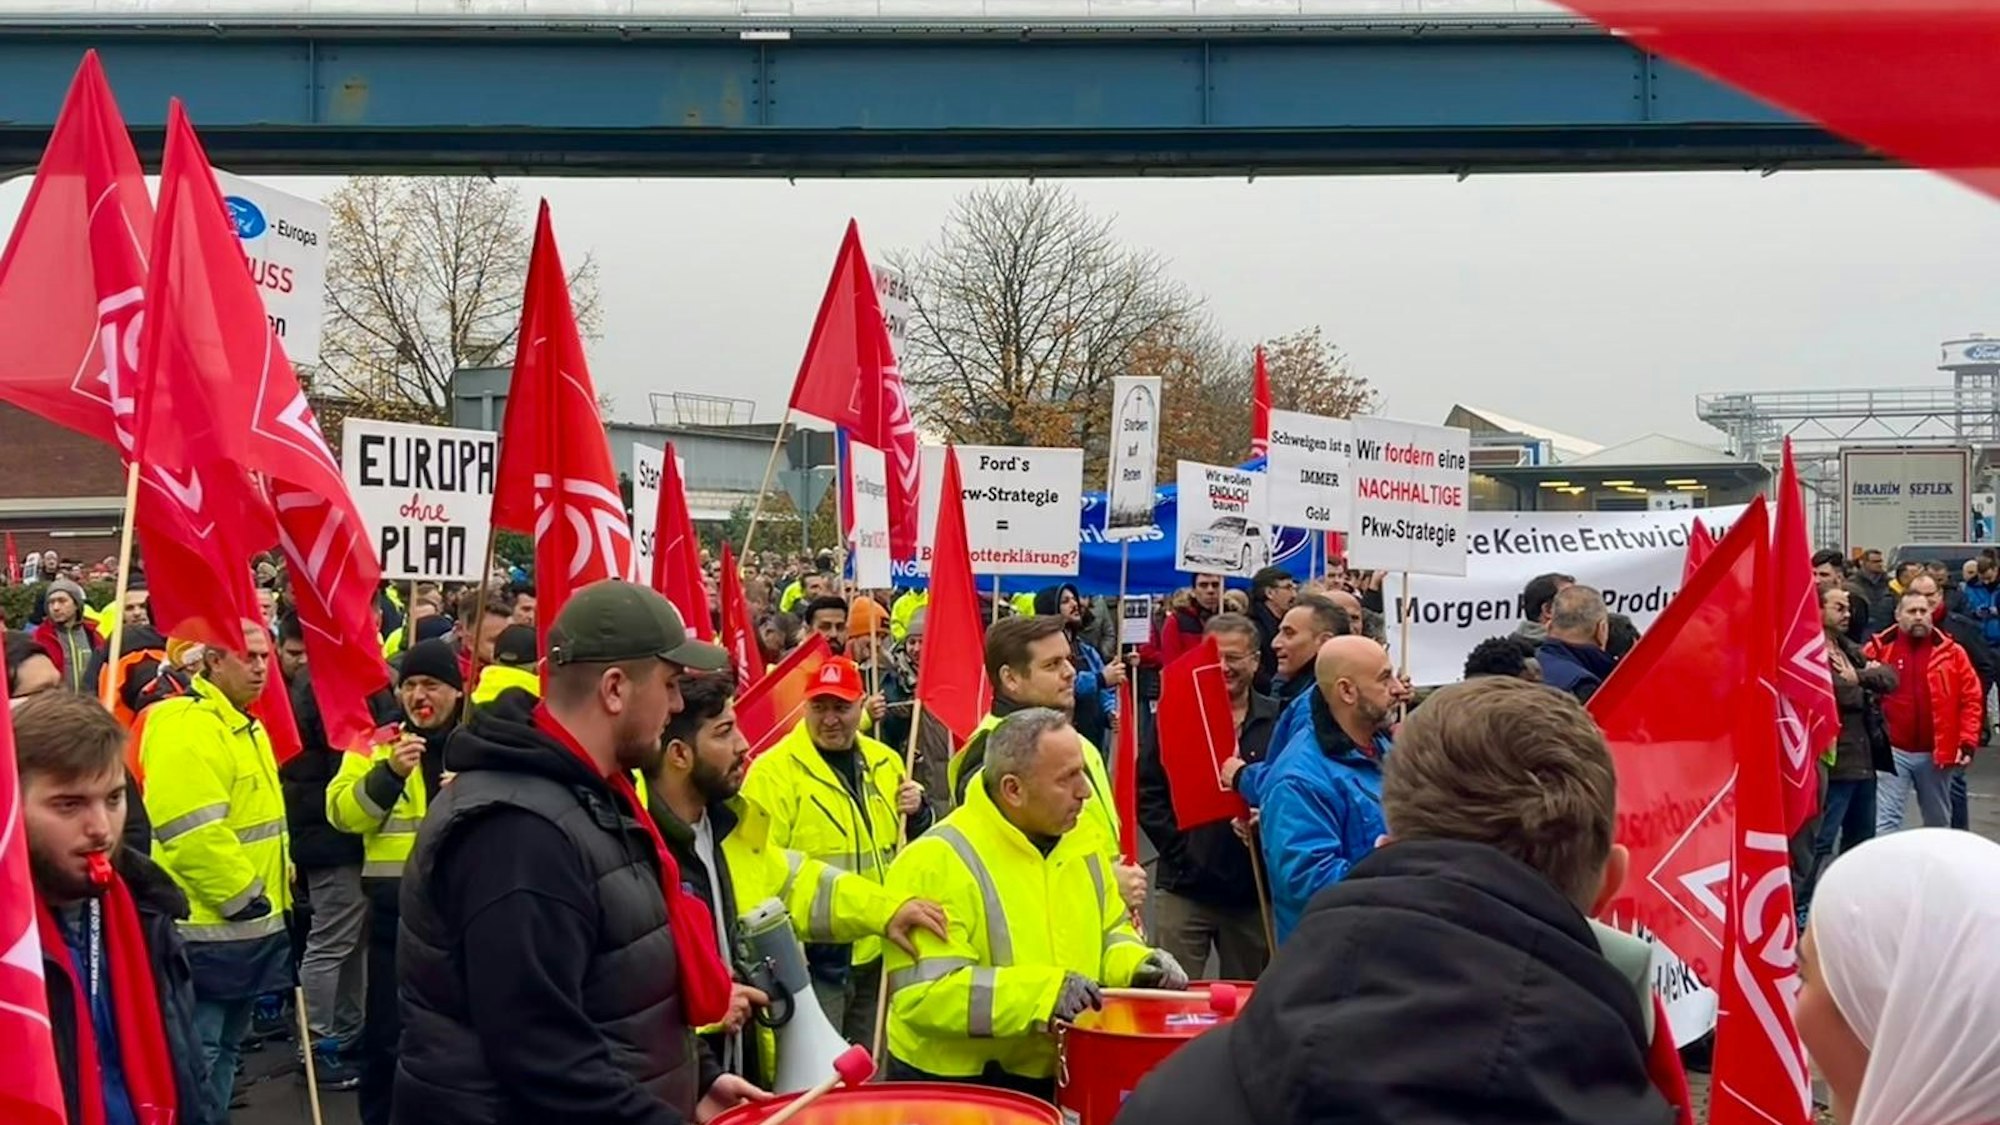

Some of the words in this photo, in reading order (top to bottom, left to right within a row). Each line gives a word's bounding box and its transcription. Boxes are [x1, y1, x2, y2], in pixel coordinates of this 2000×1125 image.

[278, 220, 317, 246] Europa
[1271, 430, 1327, 452] Schweigen
[1329, 438, 1342, 453] ist
[1356, 438, 1381, 461] Wir
[1384, 442, 1434, 467] fordern
[1439, 449, 1466, 470] eine
[360, 434, 495, 495] EUROPA
[1206, 469, 1221, 482] Wir
[1222, 472, 1252, 487] wollen
[1300, 468, 1340, 487] IMMER
[1209, 484, 1249, 500] ENDLICH
[1358, 477, 1462, 507] NACHHALTIGE
[400, 492, 450, 523] ohne
[1306, 506, 1331, 521] Gold
[1361, 516, 1456, 547] Pkw-Strategie
[1493, 528, 1579, 554] Keine
[381, 526, 466, 575] PLAN
[1395, 597, 1511, 628] Morgen
